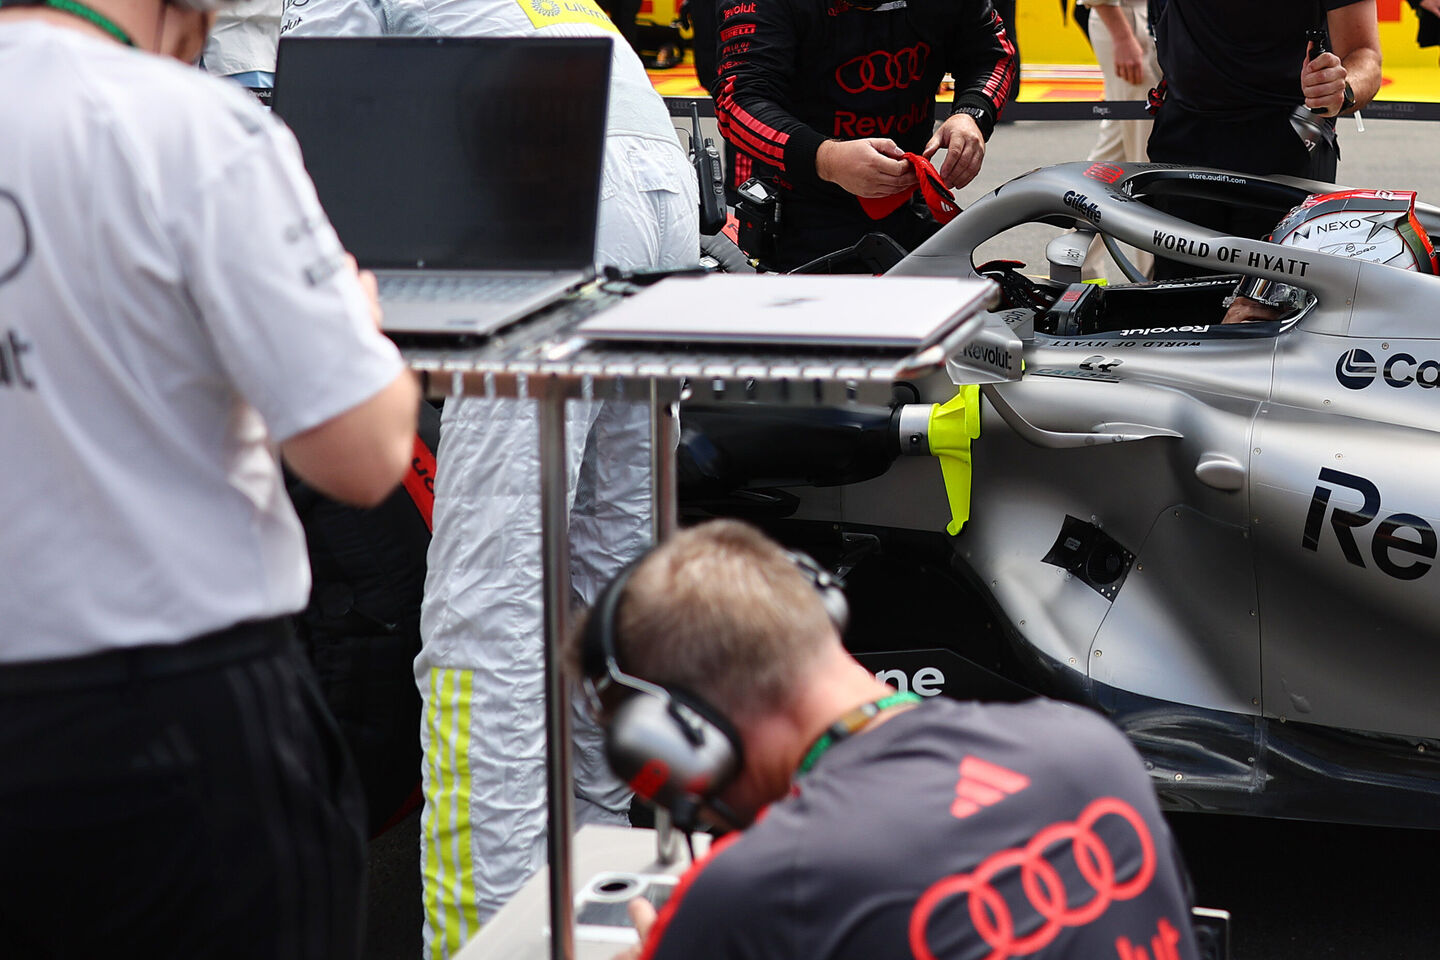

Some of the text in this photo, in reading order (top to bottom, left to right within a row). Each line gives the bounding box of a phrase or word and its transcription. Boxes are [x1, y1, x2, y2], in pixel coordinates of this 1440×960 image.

[1188, 171, 1247, 185] store.audif1.com
[1063, 189, 1102, 224] Gillette
[1316, 218, 1361, 235] NEXO
[1152, 229, 1310, 278] WORLD OF HYATT
[1119, 324, 1210, 337] Revolut
